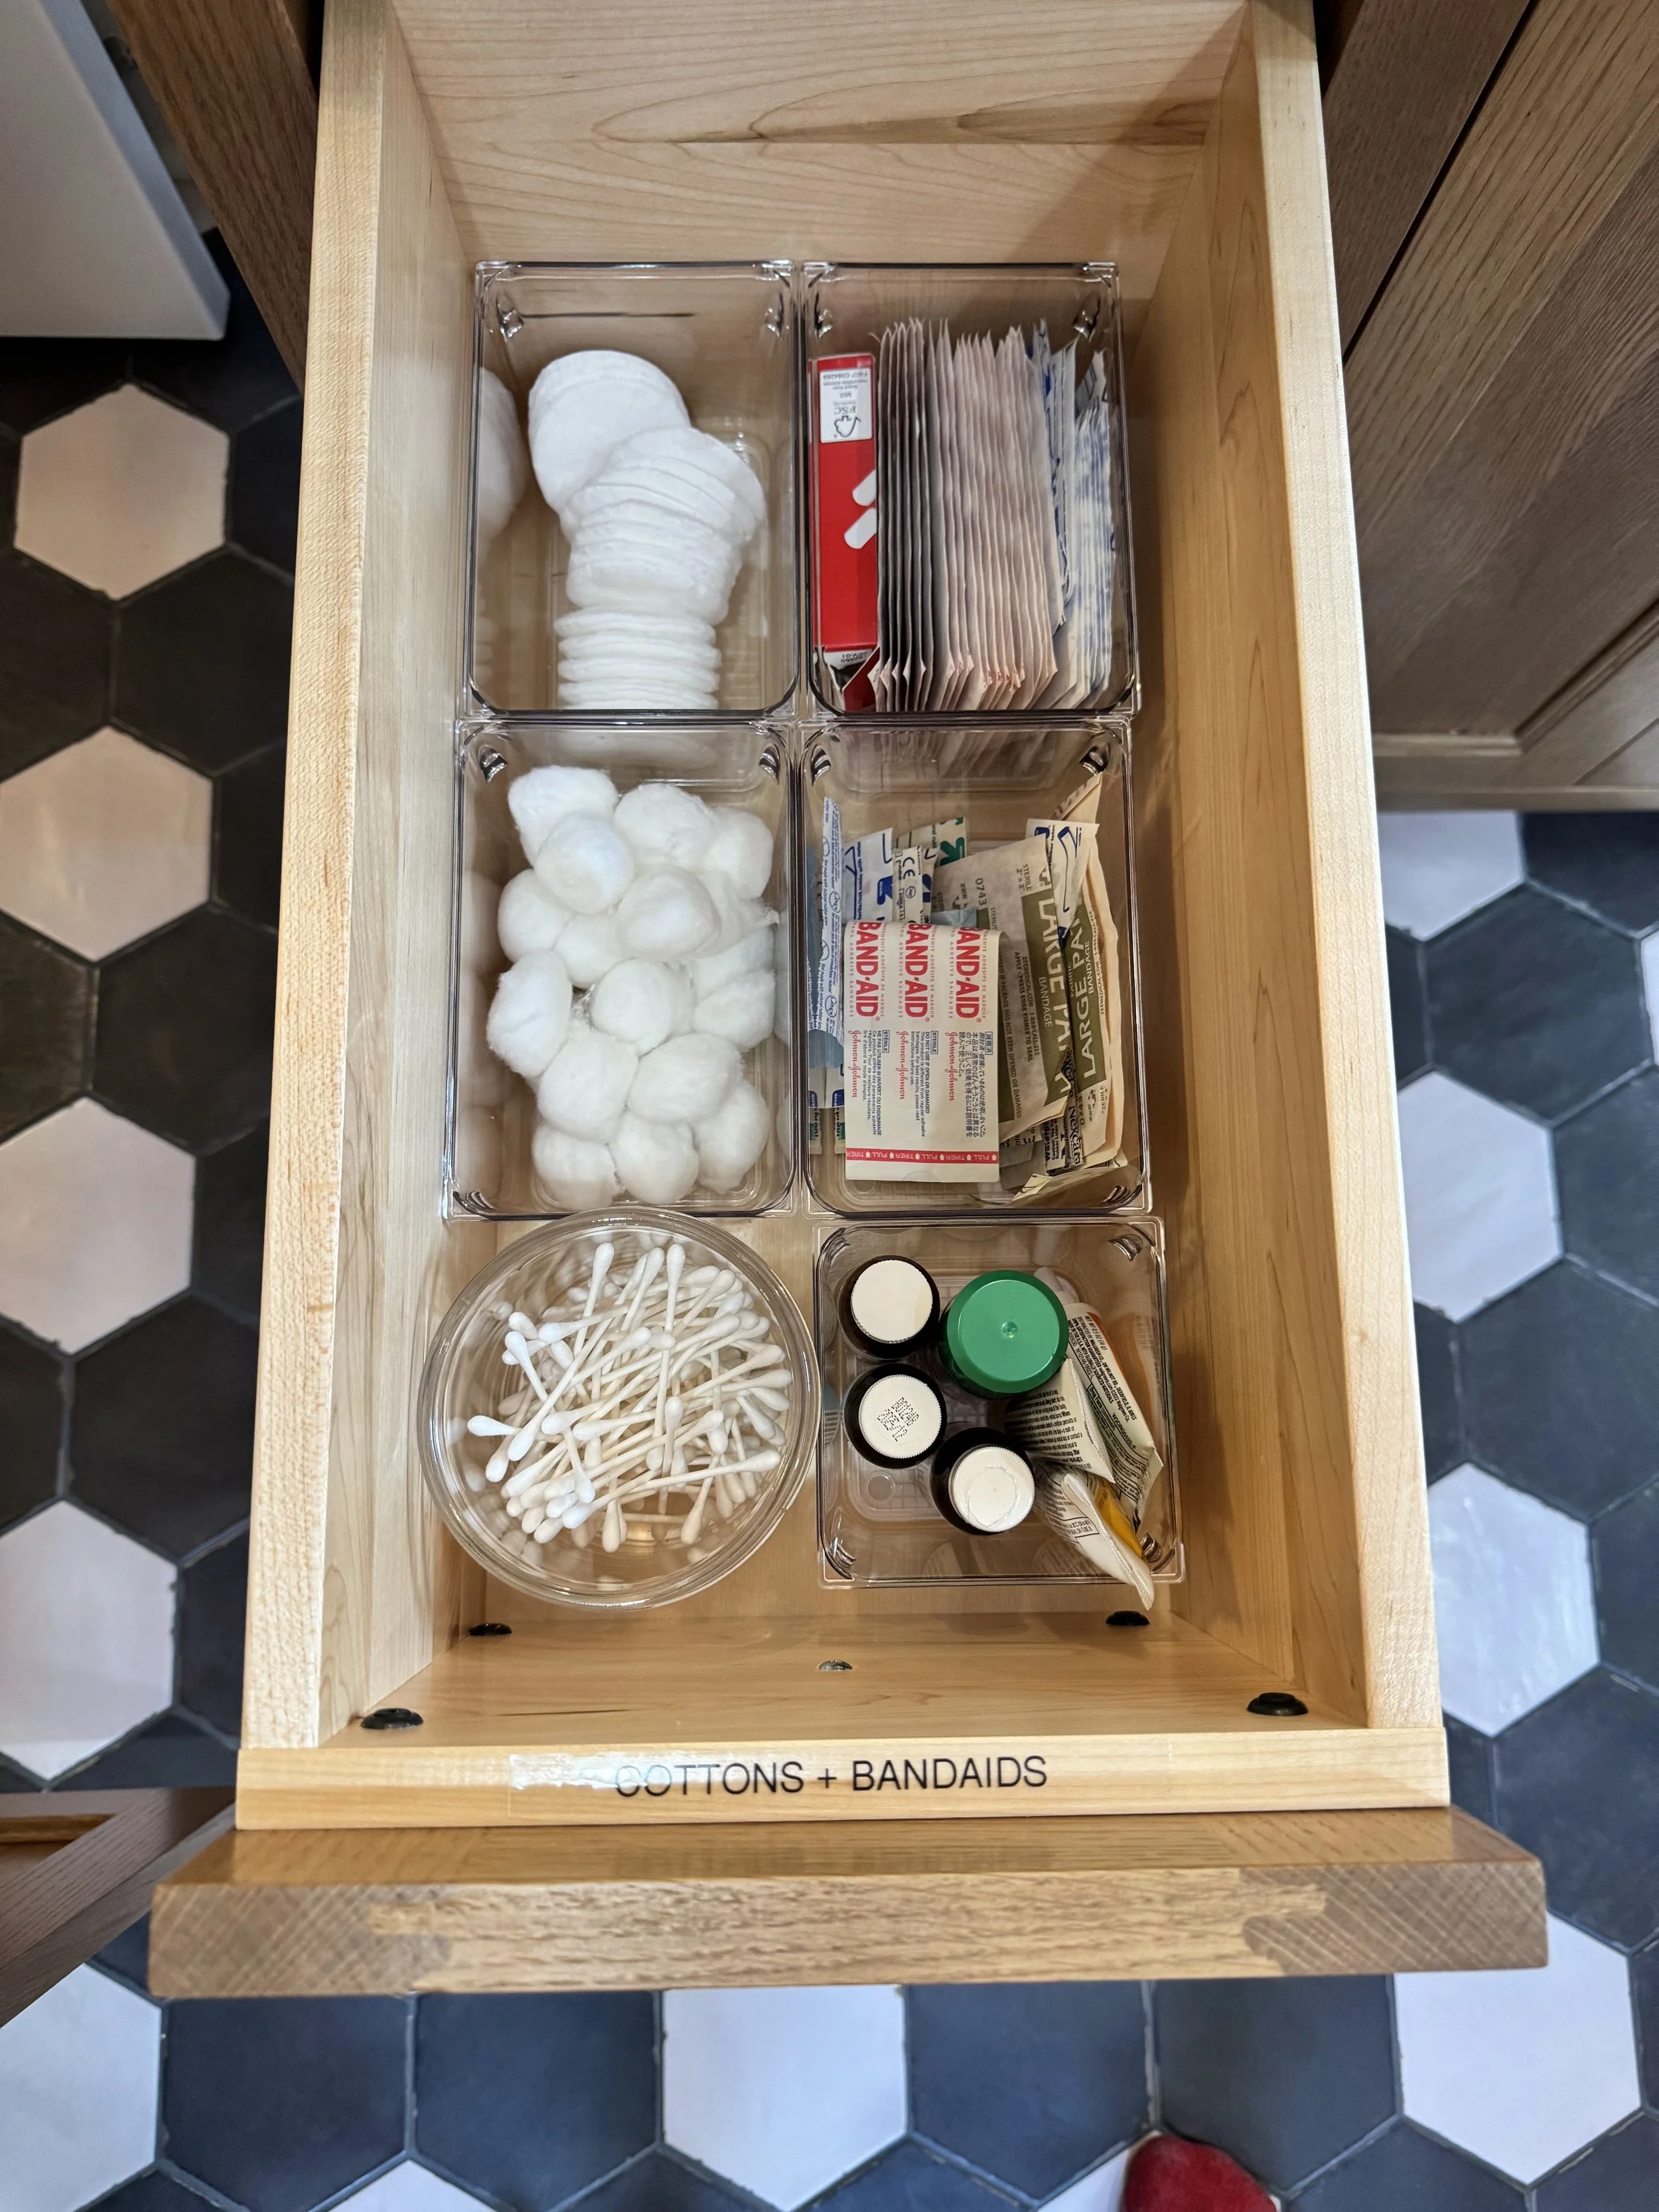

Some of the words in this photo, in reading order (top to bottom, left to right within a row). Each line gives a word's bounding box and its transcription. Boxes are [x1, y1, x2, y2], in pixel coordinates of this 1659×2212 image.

[974, 877, 987, 906] 0743
[856, 922, 881, 1016] BAND-AID
[904, 924, 932, 1017] BAND-AID
[956, 926, 981, 1018] BAND-AID
[1085, 941, 1094, 993] BANDAGE
[1038, 976, 1052, 1028] BANDAGE
[1074, 976, 1097, 1078] LARGE
[1067, 1105, 1081, 1165] Nexcare
[616, 1761, 804, 1797] COTTONS
[852, 1755, 1047, 1791] BANDAIDS
